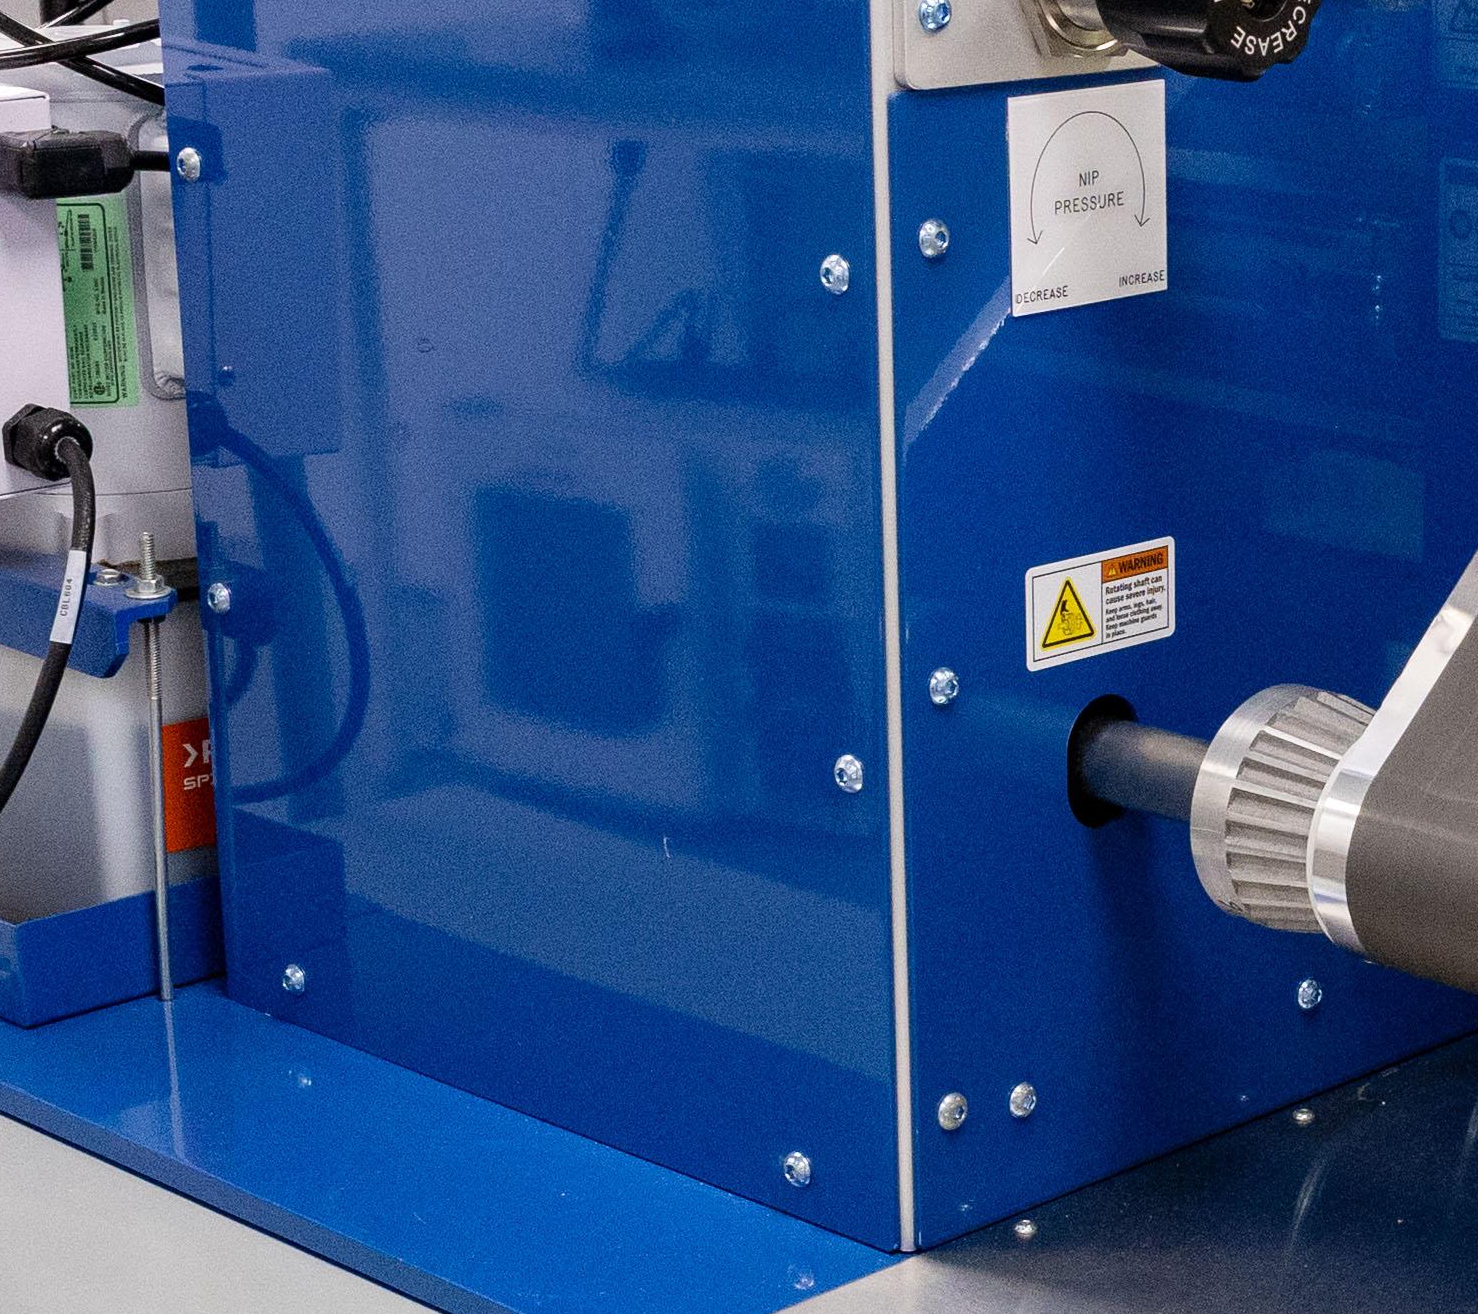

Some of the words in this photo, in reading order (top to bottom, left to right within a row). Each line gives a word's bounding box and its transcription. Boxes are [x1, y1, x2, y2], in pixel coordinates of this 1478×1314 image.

[1079, 170, 1099, 187] NIP
[1054, 191, 1124, 215] PRESSURE
[1016, 285, 1069, 304] DECREASE
[1119, 269, 1165, 287] INCREASE
[1118, 552, 1163, 574] WARNING
[1106, 582, 1132, 595] Rotating
[1134, 576, 1150, 588] shaft
[1151, 575, 1163, 585] can
[1106, 594, 1124, 605] cause
[1126, 589, 1146, 600] severe
[1147, 585, 1166, 596] injury.
[183, 774, 213, 791] SP
